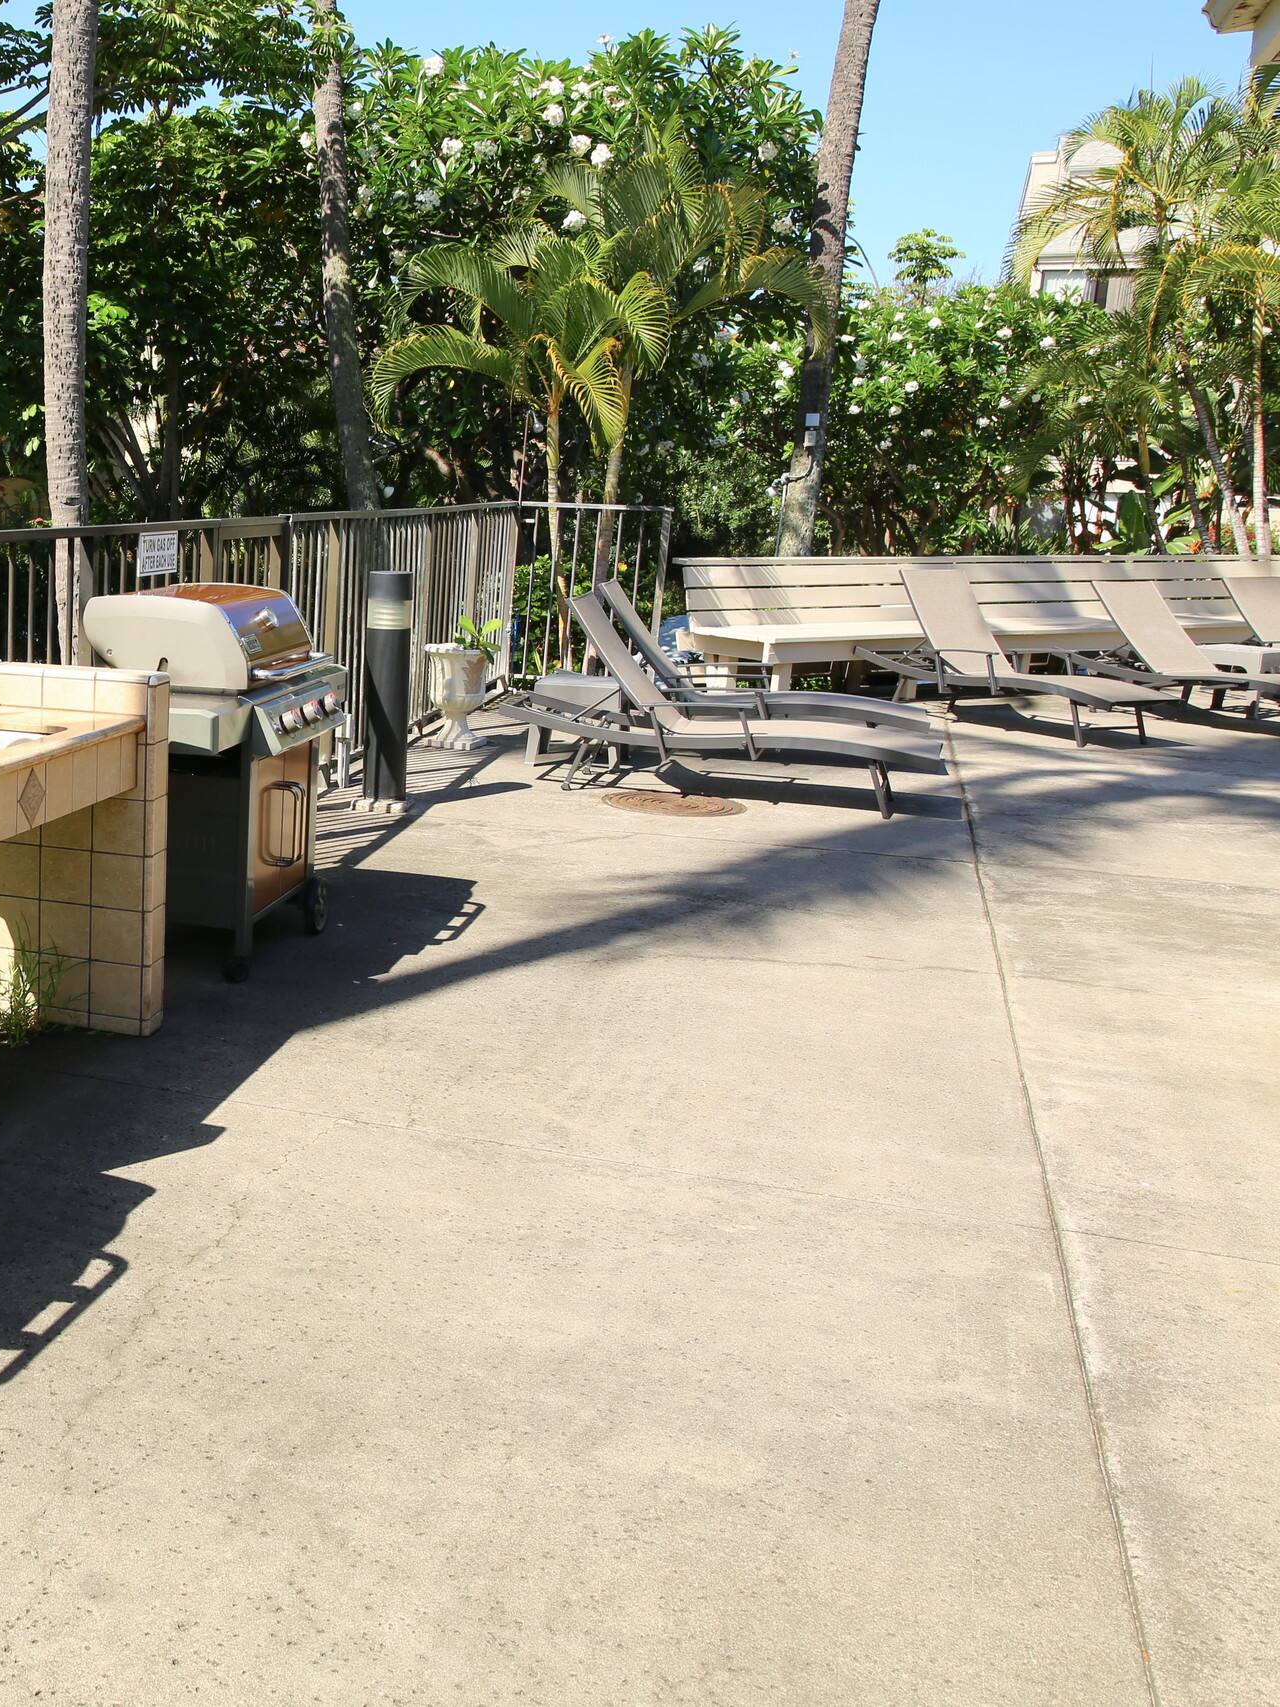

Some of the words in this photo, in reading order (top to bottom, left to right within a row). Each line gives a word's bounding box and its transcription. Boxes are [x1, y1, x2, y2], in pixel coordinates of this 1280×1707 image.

[143, 539, 156, 553] TURN
[157, 538, 166, 552] GAS
[167, 537, 176, 551] OFF
